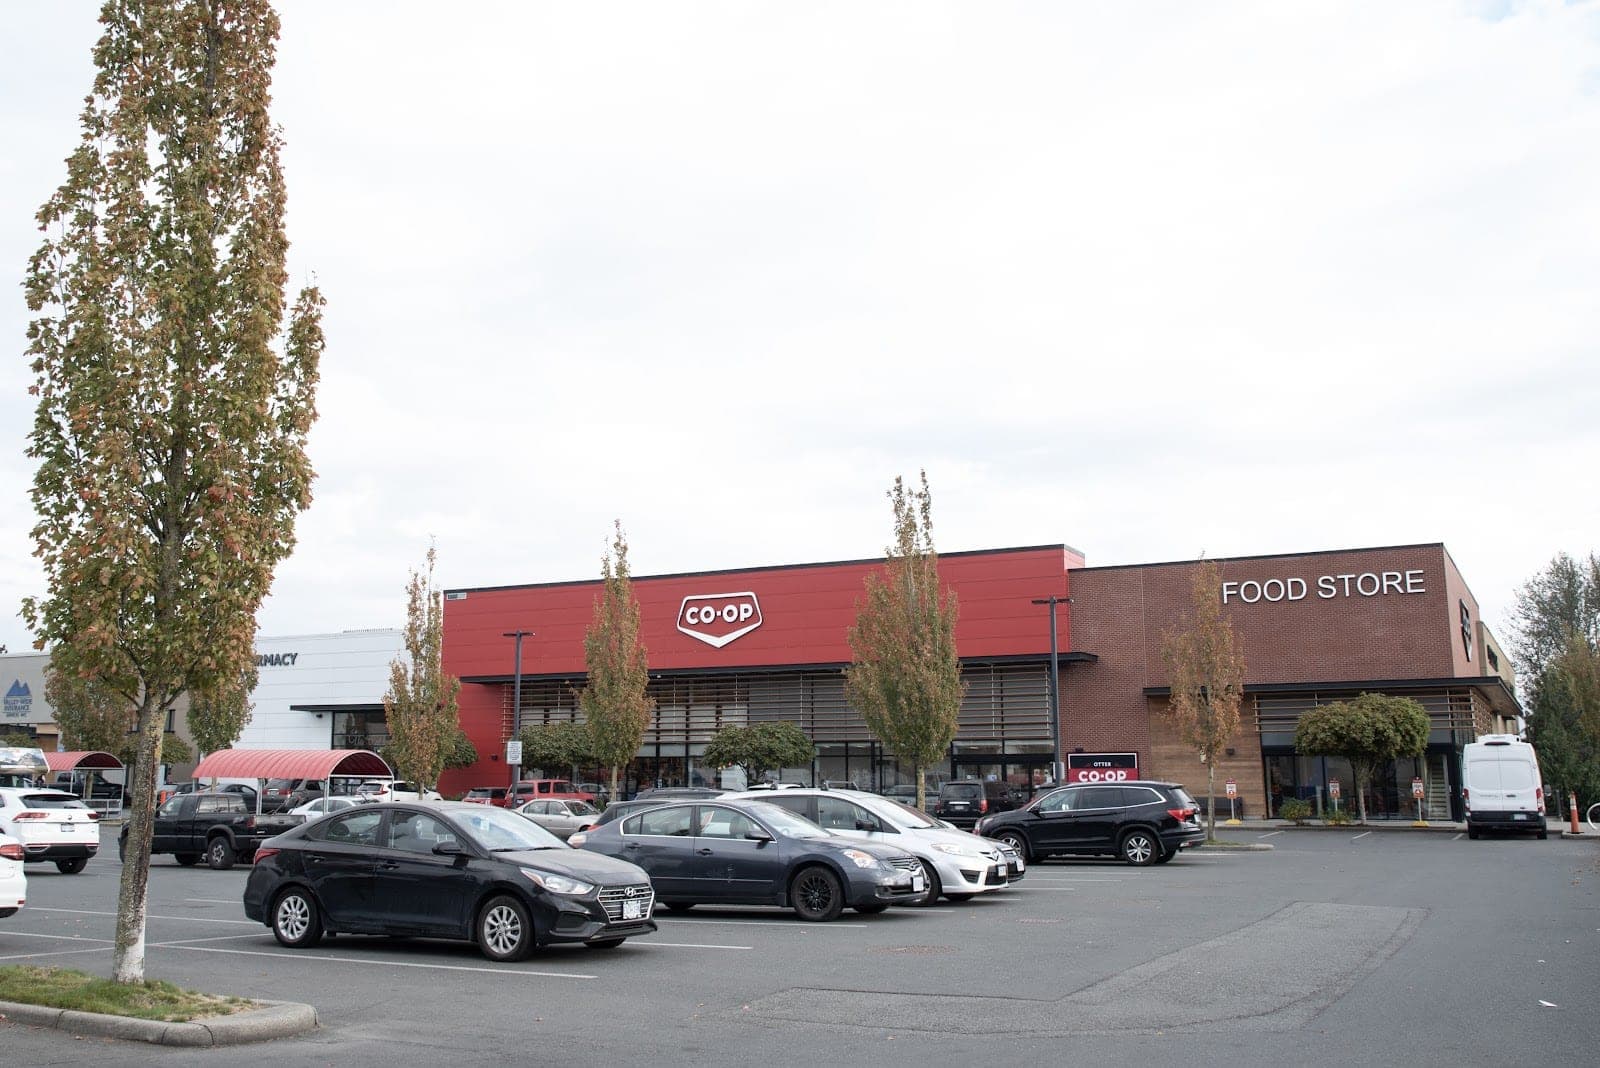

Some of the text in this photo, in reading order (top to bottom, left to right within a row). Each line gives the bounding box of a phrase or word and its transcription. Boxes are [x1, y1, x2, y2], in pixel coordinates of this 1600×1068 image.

[1222, 570, 1426, 604] FOOD STORE
[686, 603, 753, 624] CO-OP
[254, 652, 298, 667] RMACY
[1078, 770, 1127, 783] CO-OP
